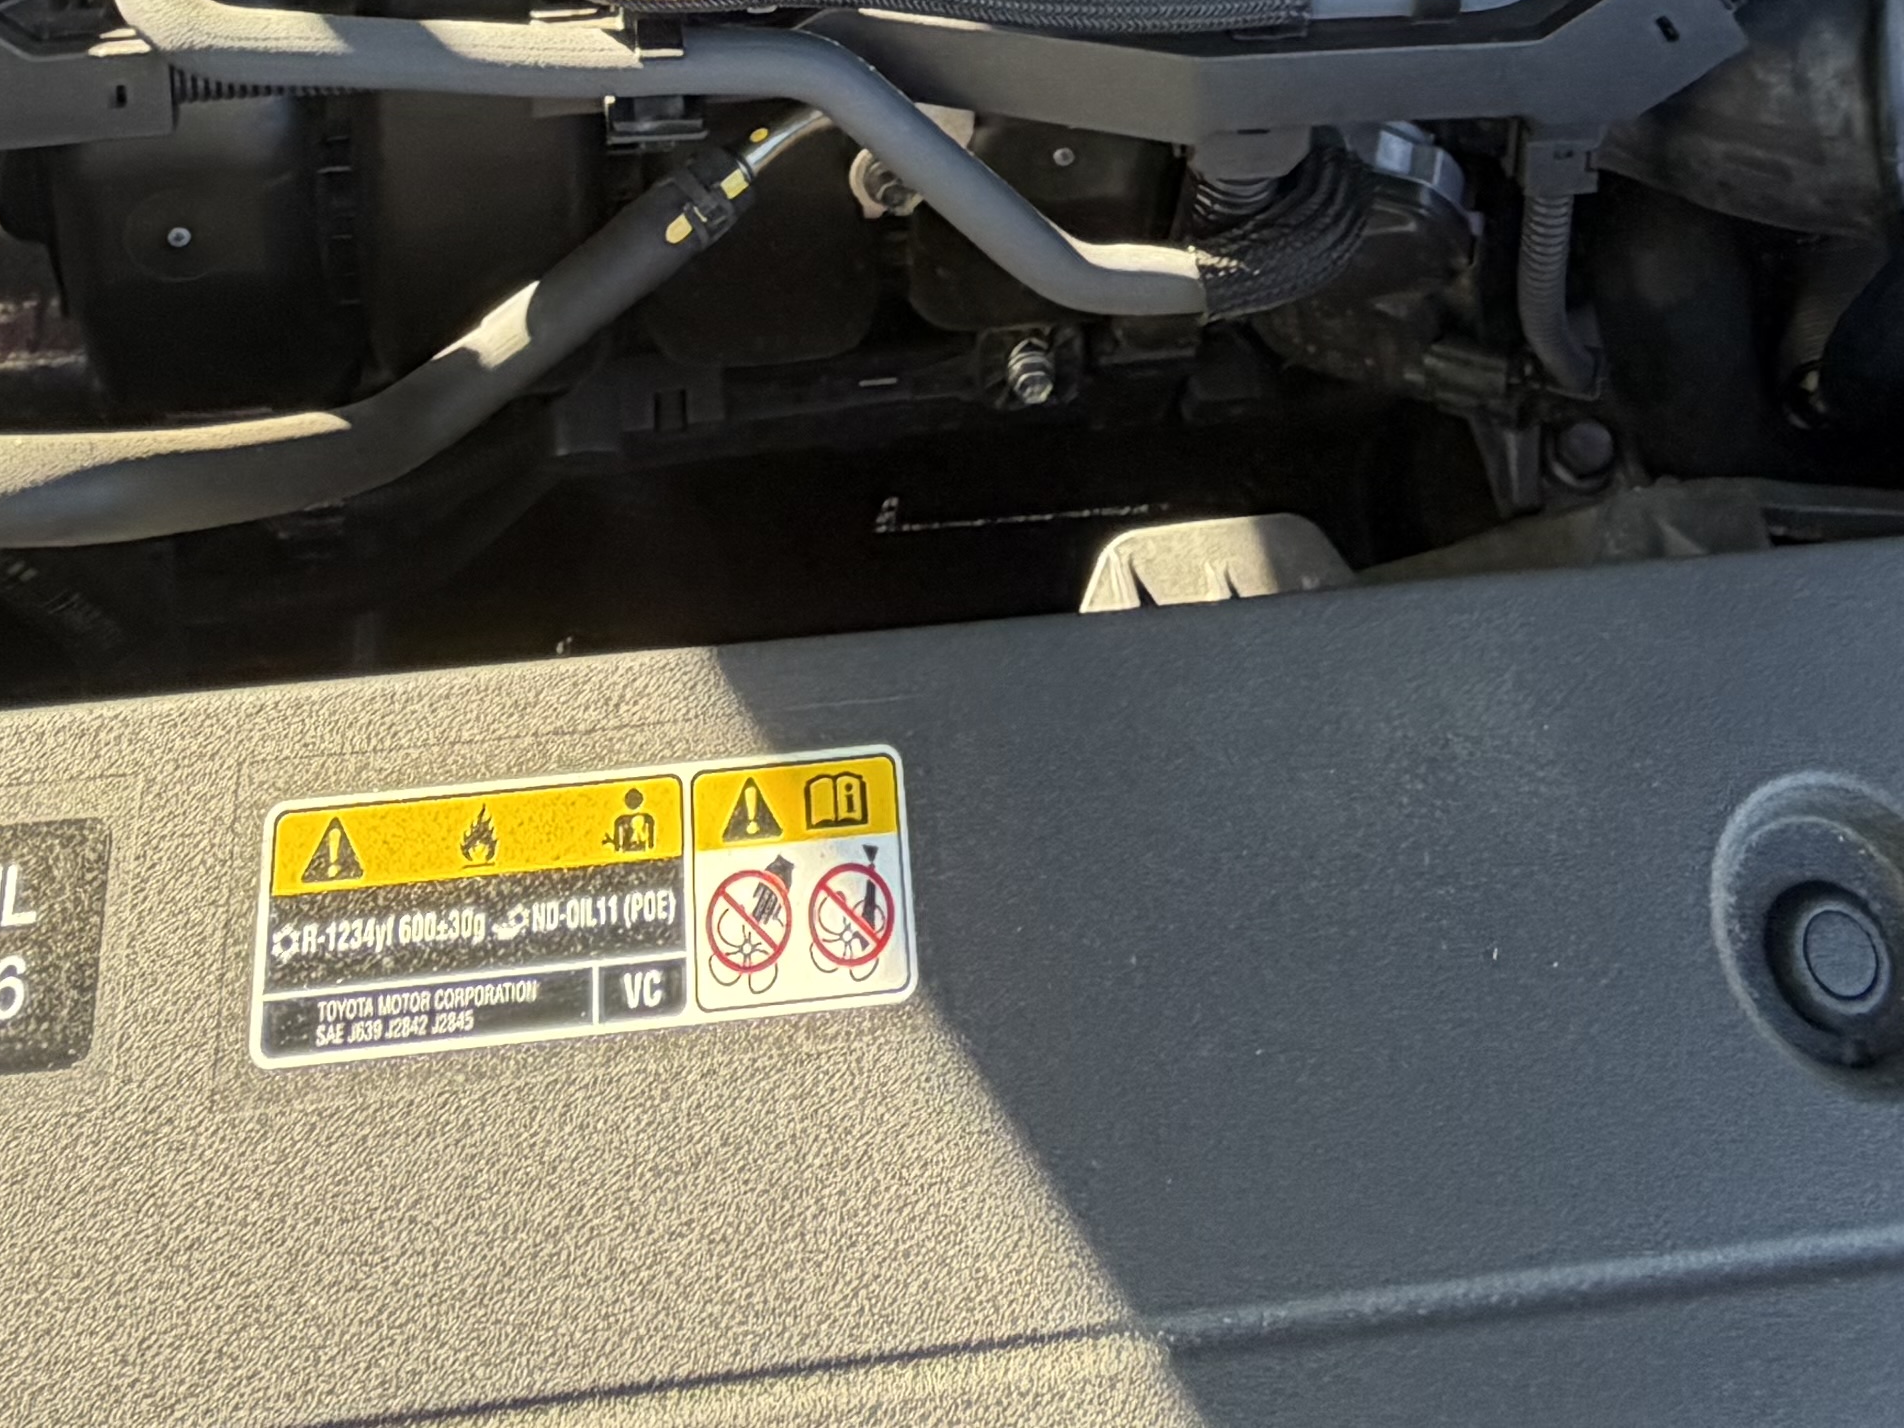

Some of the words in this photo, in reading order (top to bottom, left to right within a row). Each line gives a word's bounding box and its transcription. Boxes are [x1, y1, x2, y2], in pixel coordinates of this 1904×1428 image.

[301, 917, 395, 952] R-1234yf
[398, 907, 486, 944] 600±30g
[623, 890, 677, 924] (POE)
[317, 996, 374, 1022] TOYOTA
[378, 990, 430, 1015] MOTOR
[434, 981, 538, 1010] CORPORATION
[623, 969, 663, 1009] VC
[316, 1023, 345, 1047] SAE
[348, 1020, 383, 1043] J639
[385, 1016, 429, 1040] J2842
